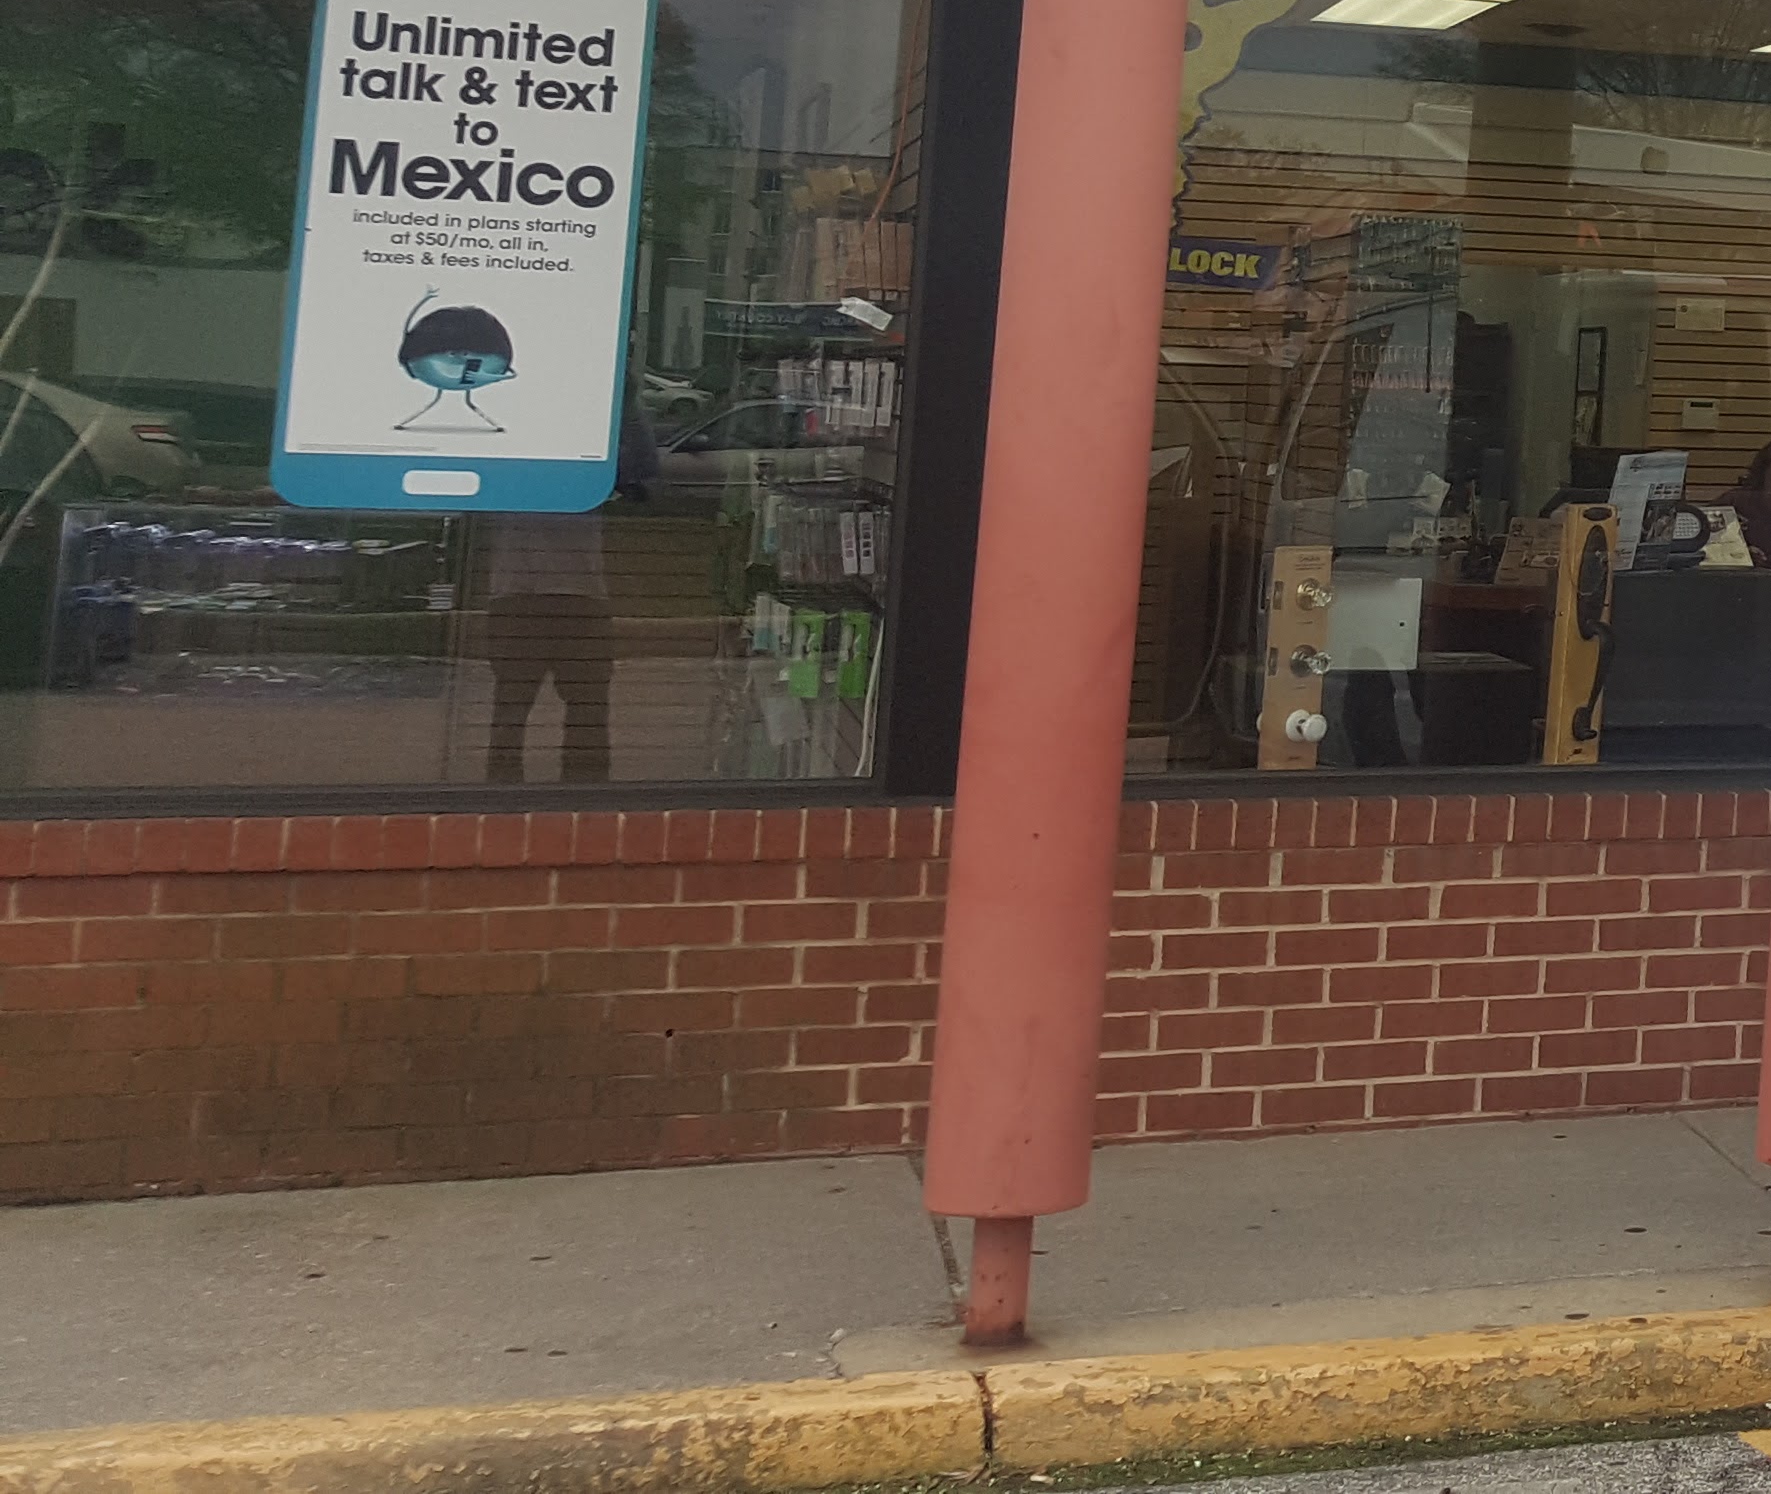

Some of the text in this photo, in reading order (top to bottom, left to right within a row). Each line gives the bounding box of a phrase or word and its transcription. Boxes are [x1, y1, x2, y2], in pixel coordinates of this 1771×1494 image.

[352, 10, 615, 67] Unlimited
[339, 58, 619, 113] talk & text
[453, 112, 499, 146] to
[328, 137, 615, 209] Mexico
[352, 209, 597, 238] included in plans starting
[390, 231, 411, 246] at
[499, 236, 522, 251] all
[362, 249, 575, 272] taxes & fees included.
[1168, 246, 1262, 279] LOCK
